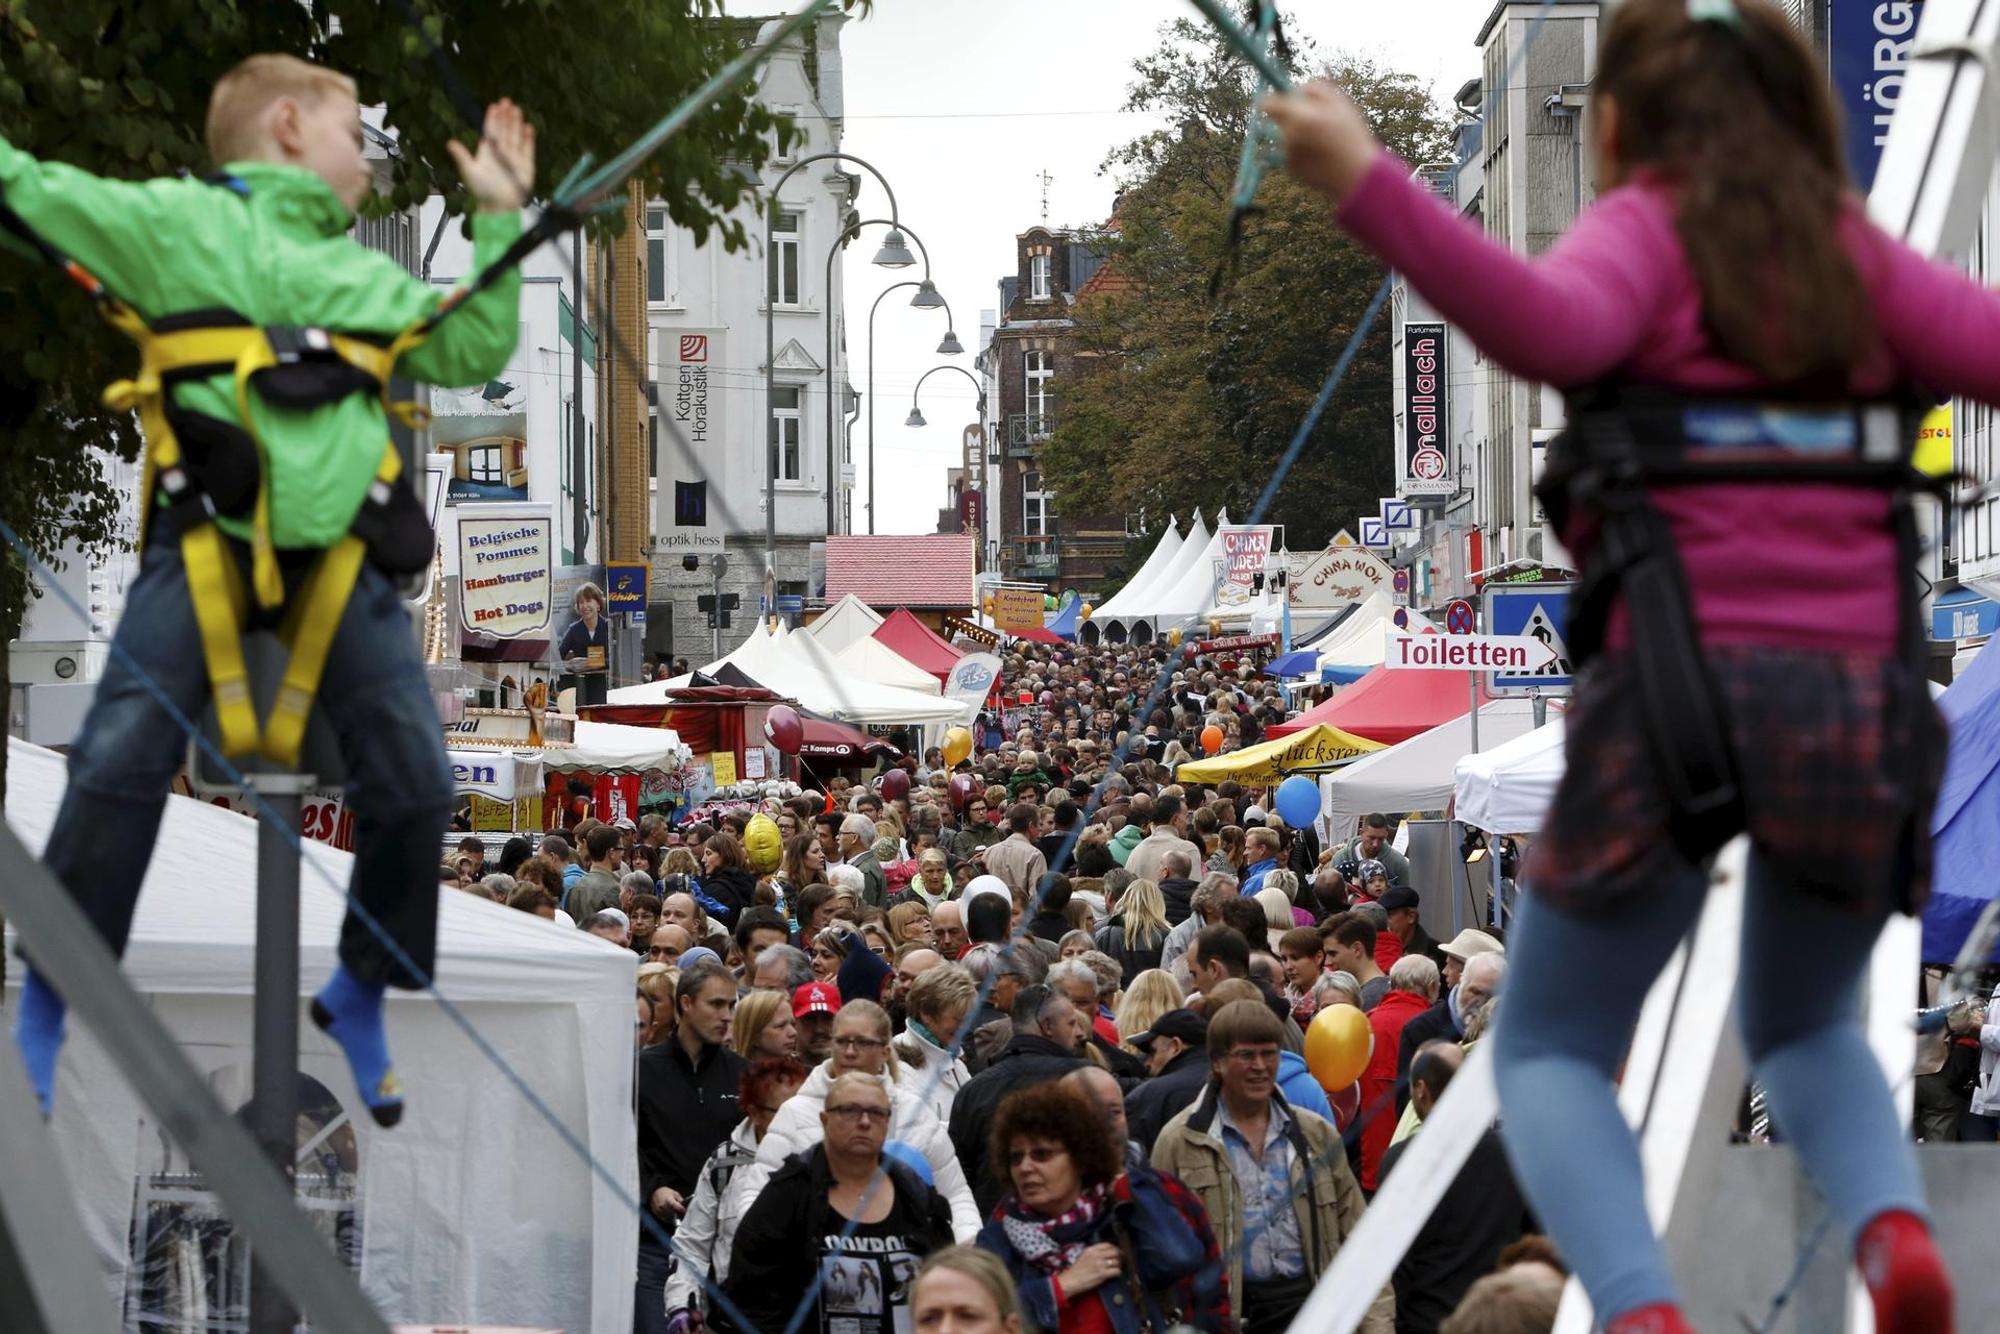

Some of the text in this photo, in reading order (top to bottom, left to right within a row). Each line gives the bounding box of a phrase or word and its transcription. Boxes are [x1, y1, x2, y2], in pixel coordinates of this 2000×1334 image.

[675, 364, 694, 421] Köttgen
[692, 365, 707, 442] Hörakustik
[468, 527, 540, 547] Belgische
[660, 533, 720, 547] optik hess
[1225, 534, 1266, 553] CHINA
[475, 545, 539, 563] Pommes
[465, 569, 546, 591] Hamburger
[1313, 559, 1383, 586] CHINA WOK
[474, 607, 504, 622] Hot
[505, 601, 544, 616] Dogs
[1212, 638, 1239, 648] CHINA
[1396, 638, 1527, 666] Toiletten
[810, 744, 836, 753] Kamps
